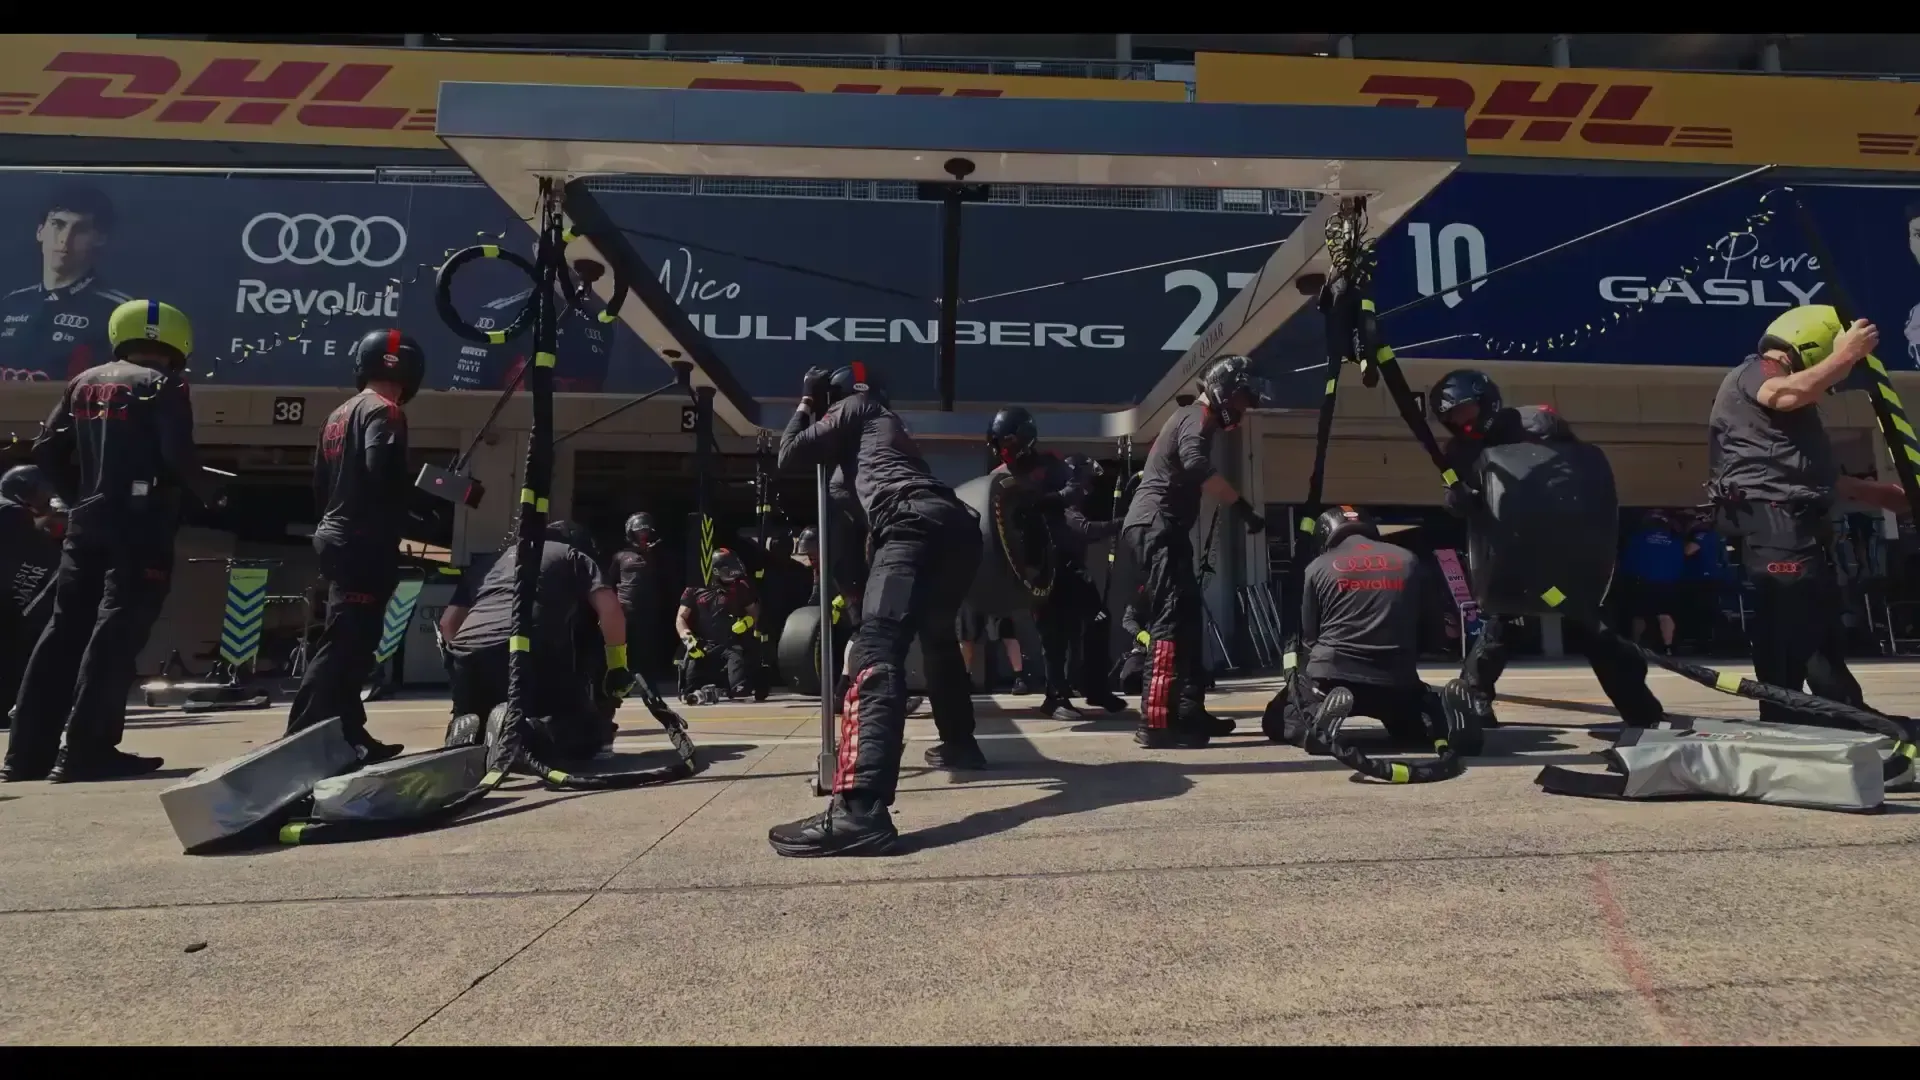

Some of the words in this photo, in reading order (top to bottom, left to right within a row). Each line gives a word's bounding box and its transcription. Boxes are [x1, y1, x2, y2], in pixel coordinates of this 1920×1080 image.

[29, 51, 409, 131] DHL
[1408, 222, 1487, 309] 10
[1716, 232, 1820, 280] Pierre
[658, 247, 741, 306] Nico
[1599, 276, 1826, 307] GASLY
[236, 279, 400, 318] Revolut
[1161, 269, 1257, 351] 2
[300, 339, 359, 356] TE
[687, 313, 1126, 349] ULKENBERG
[275, 402, 302, 421] 38
[683, 411, 699, 429] 3
